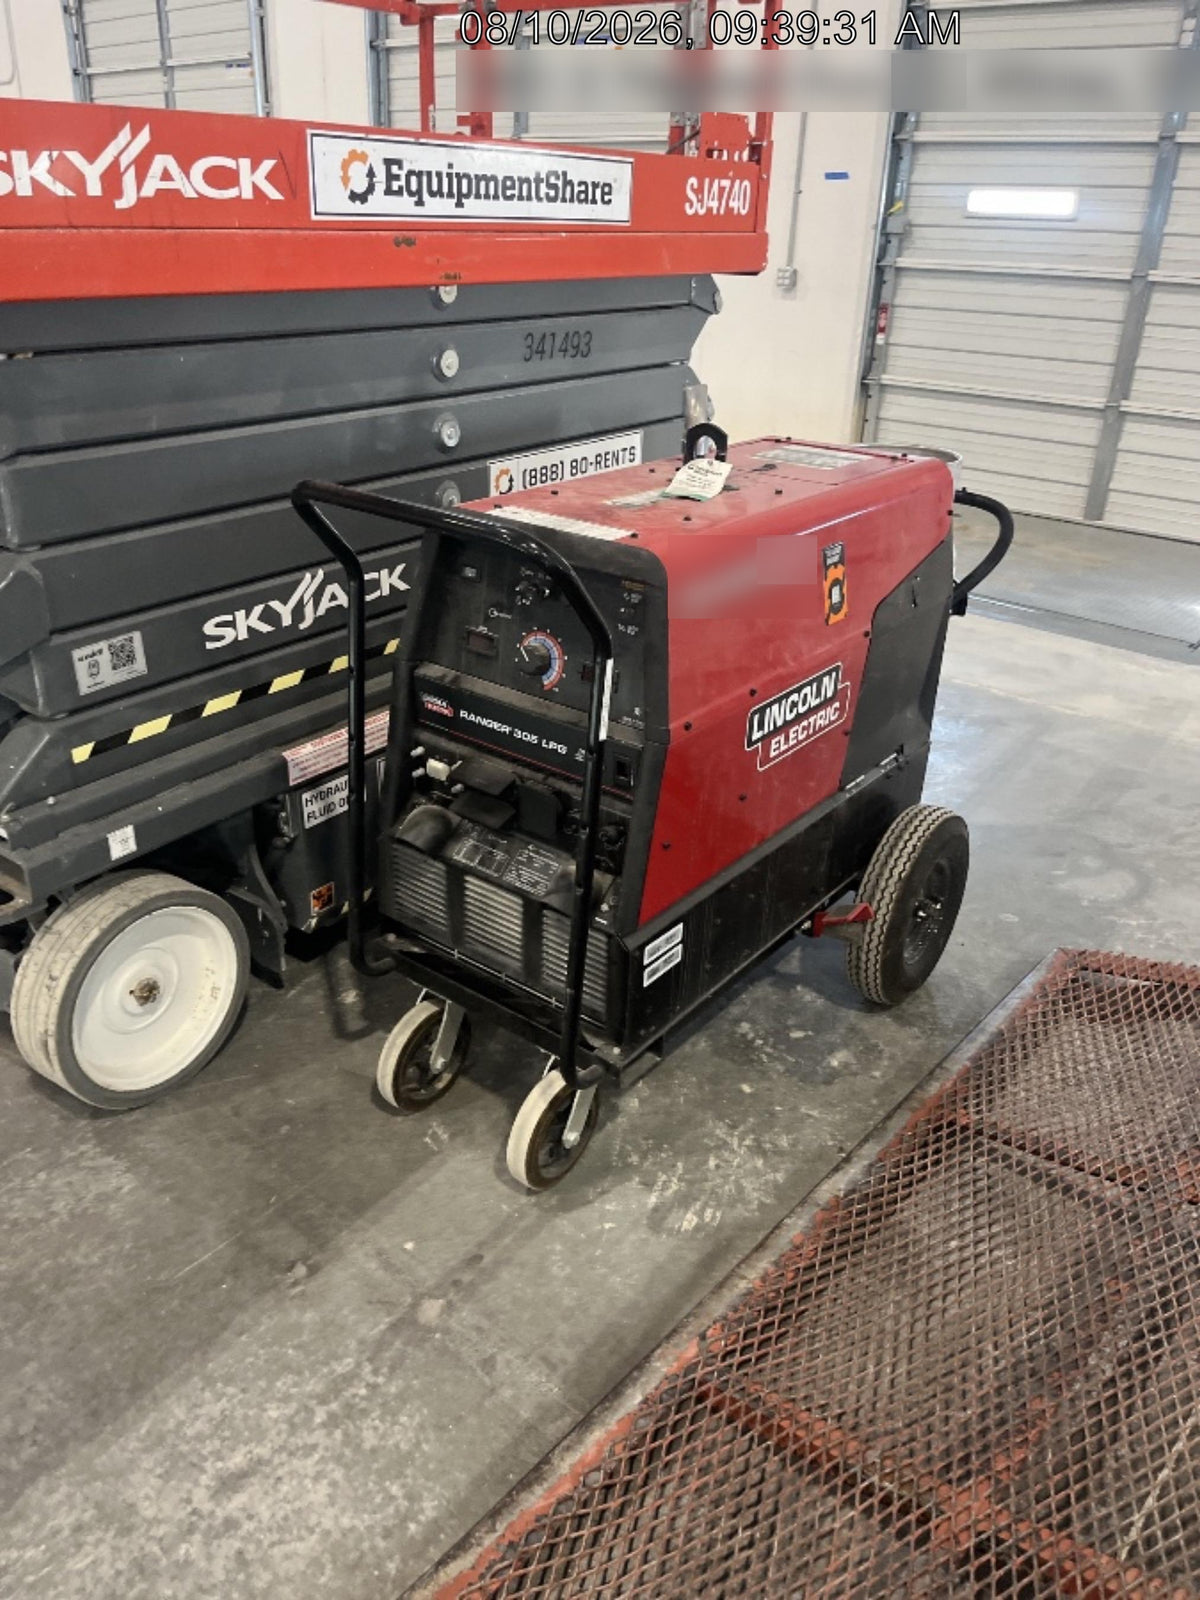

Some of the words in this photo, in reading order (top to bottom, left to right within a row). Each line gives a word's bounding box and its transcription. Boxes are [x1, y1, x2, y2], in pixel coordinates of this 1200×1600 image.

[0, 121, 285, 209] KYJACK
[383, 157, 612, 208] EquipmentShare
[684, 176, 751, 216] SJ4740
[523, 330, 593, 362] 341493
[522, 460, 565, 489] (888)
[570, 446, 636, 477] 80-RENTS
[751, 672, 837, 742] LINCOLN
[460, 709, 510, 735] RANGER
[514, 728, 538, 744] 305
[541, 738, 568, 755] LPG
[769, 702, 840, 758] ELECTRIC
[305, 779, 348, 808] HYDRAU
[306, 802, 337, 823] FLUID
